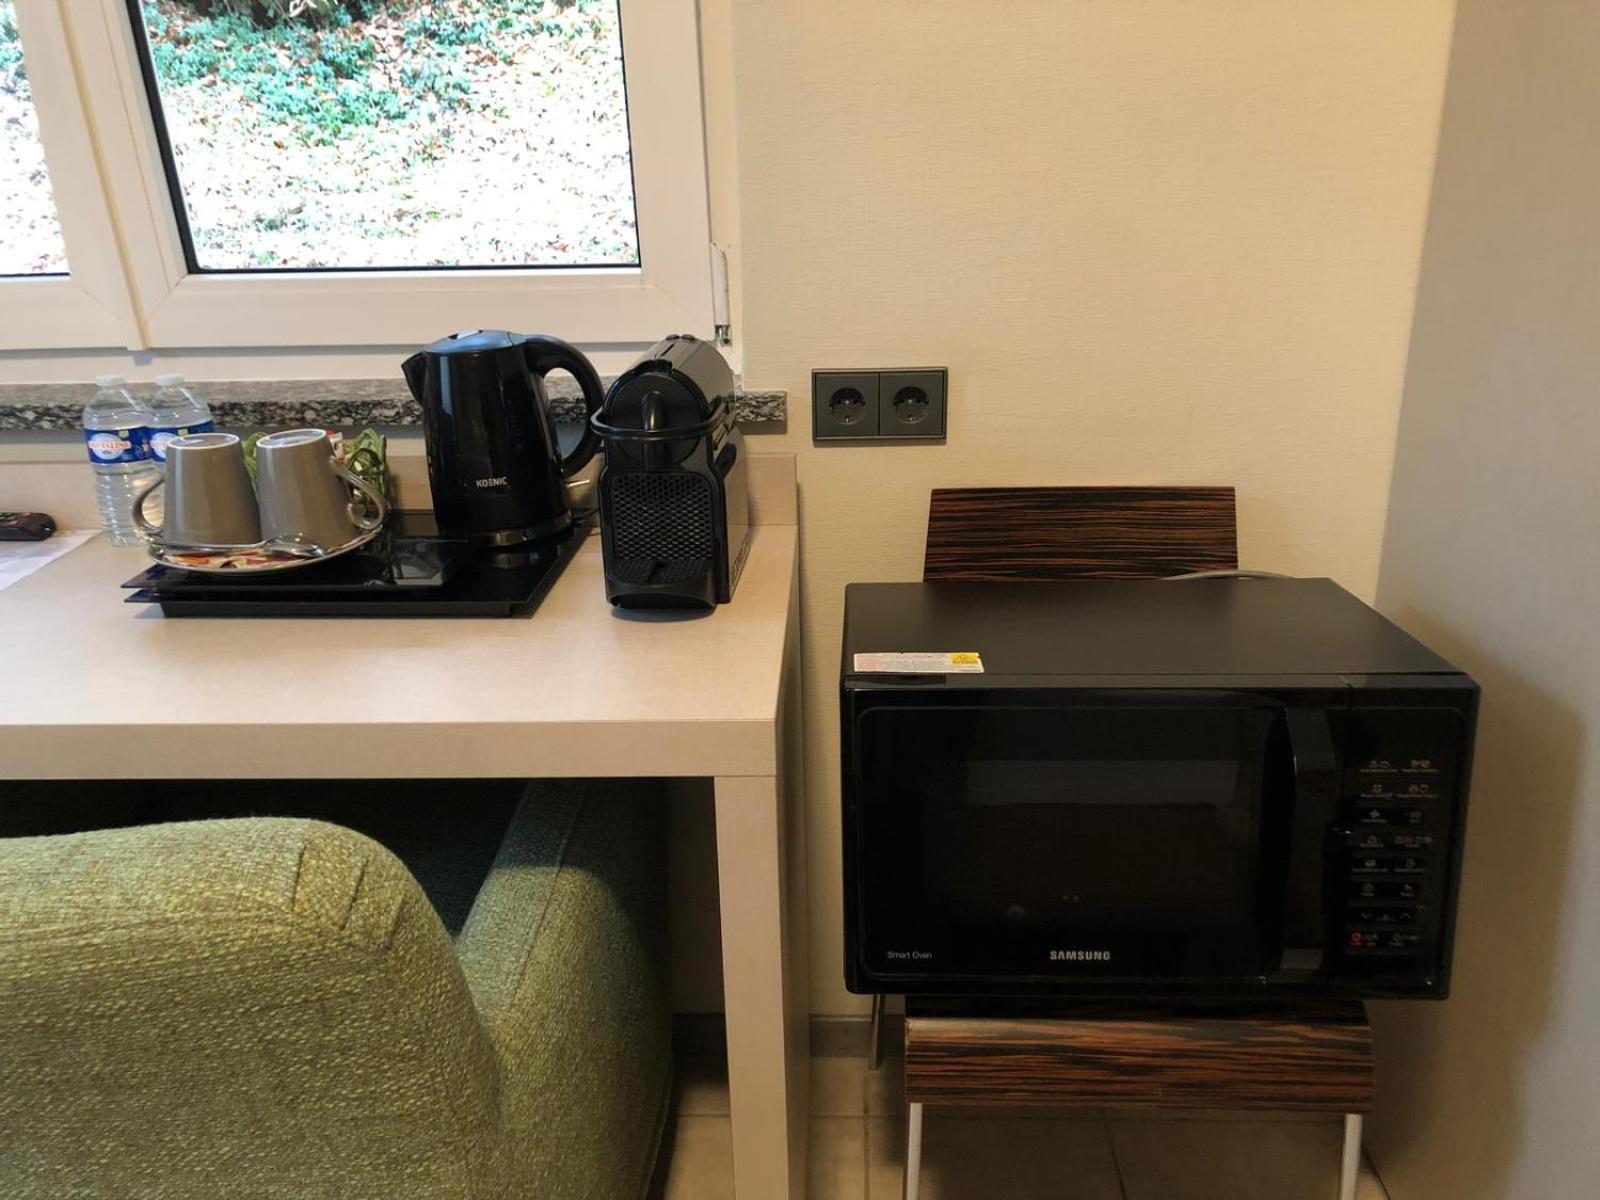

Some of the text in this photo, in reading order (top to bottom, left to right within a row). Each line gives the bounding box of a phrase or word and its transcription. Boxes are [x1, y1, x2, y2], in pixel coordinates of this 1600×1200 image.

[475, 476, 508, 489] KOENIC
[887, 950, 933, 960] Smart Oven
[1049, 950, 1111, 961] SAMSUNG
